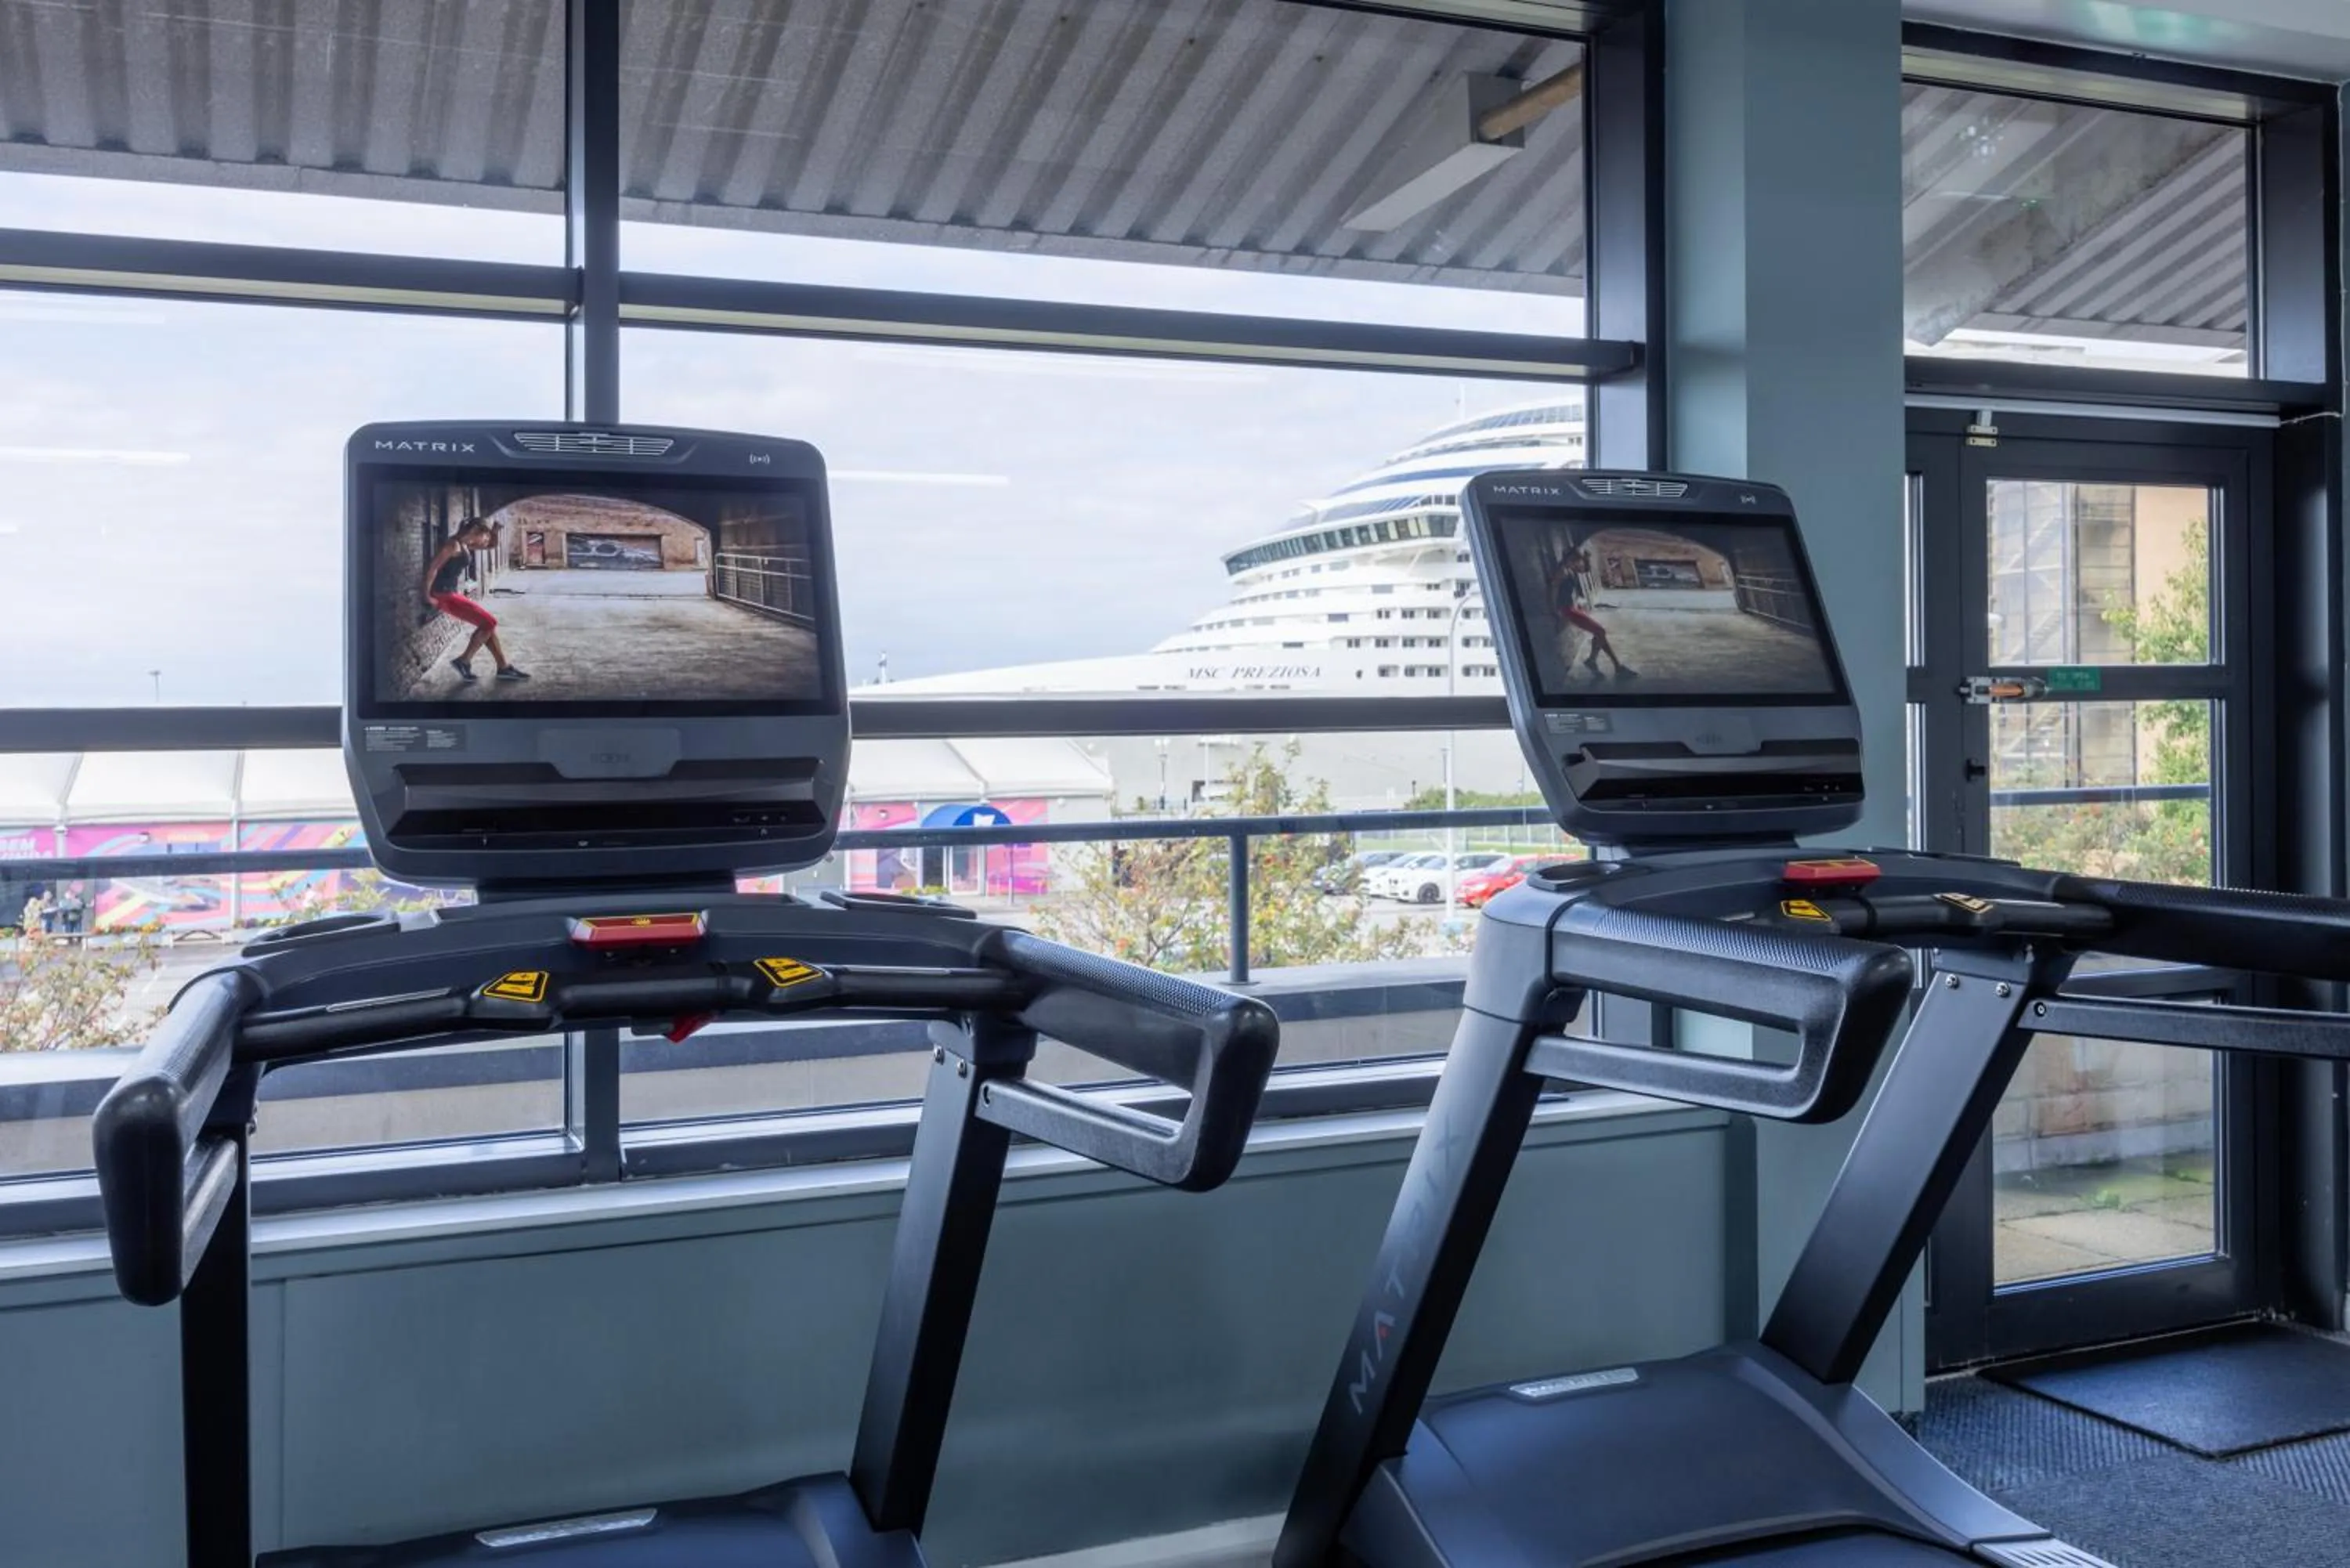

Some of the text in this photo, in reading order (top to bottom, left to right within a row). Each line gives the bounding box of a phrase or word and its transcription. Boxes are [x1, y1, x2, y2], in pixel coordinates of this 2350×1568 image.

[374, 439, 475, 453] MATRIX
[1492, 486, 1561, 495] MATRIX
[1188, 666, 1322, 679] MSC PREZIOSA
